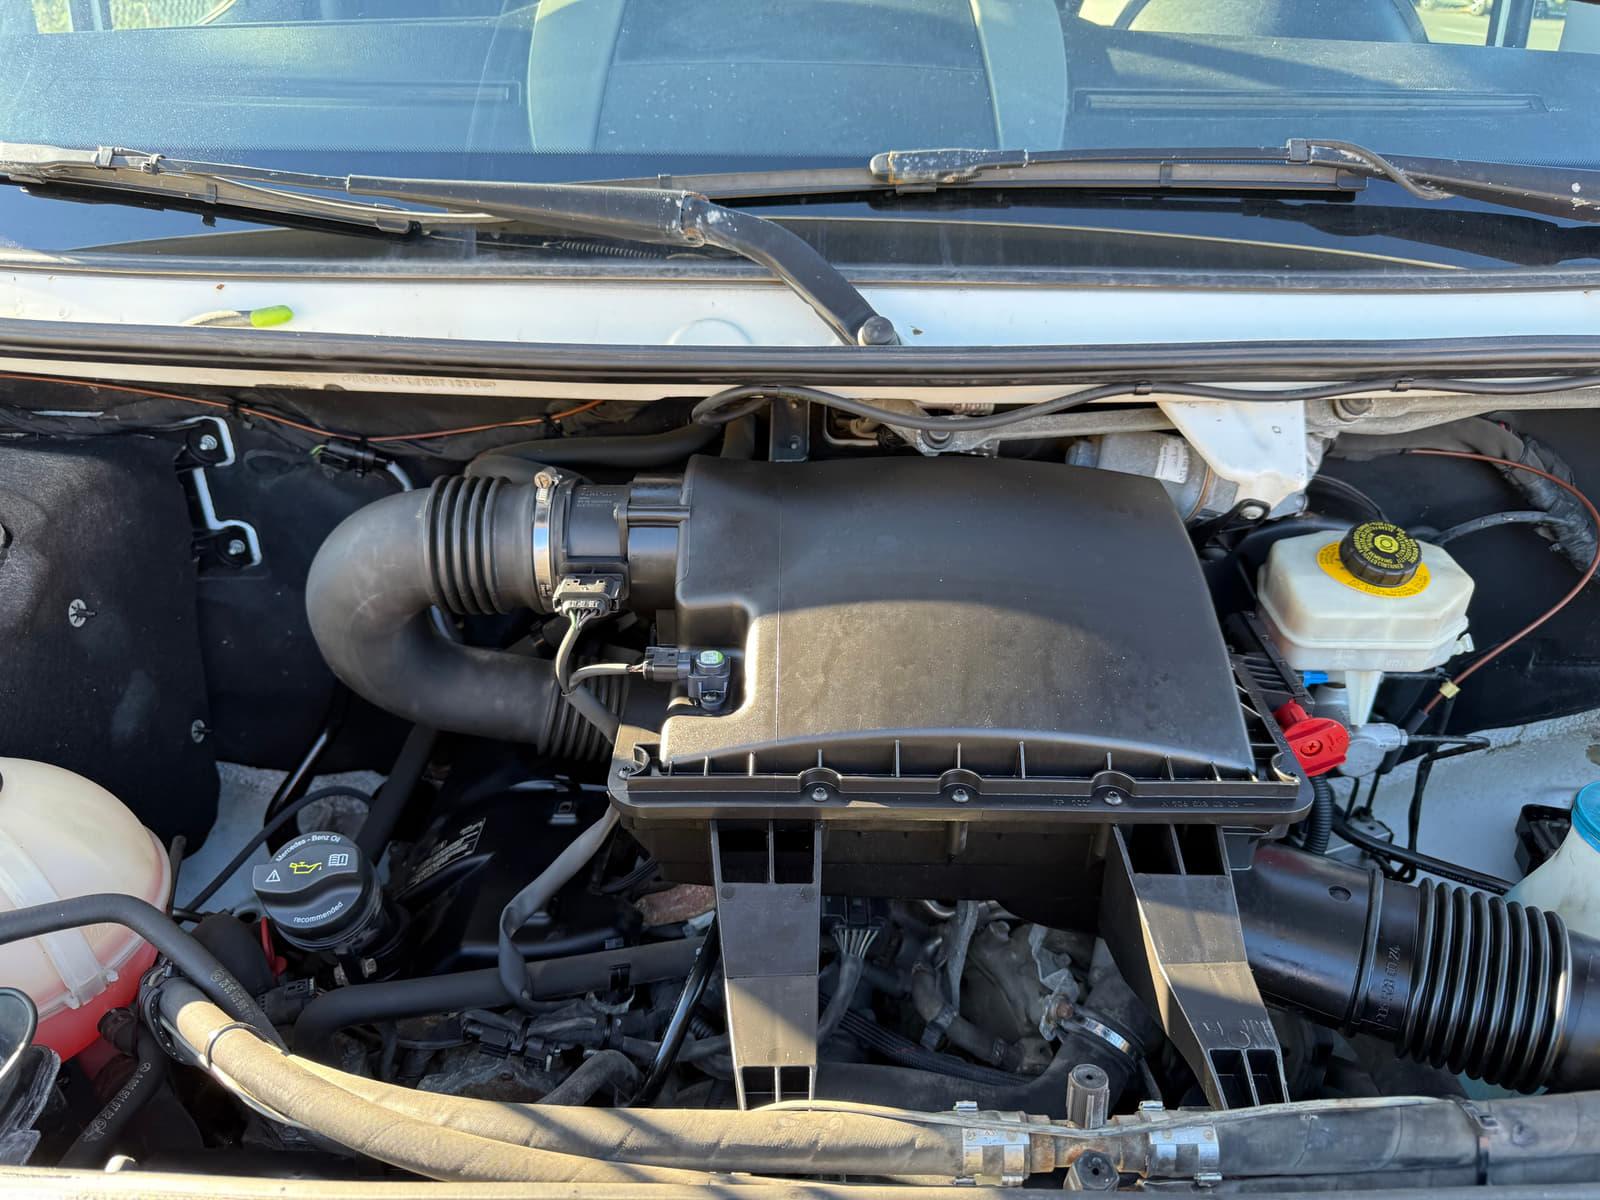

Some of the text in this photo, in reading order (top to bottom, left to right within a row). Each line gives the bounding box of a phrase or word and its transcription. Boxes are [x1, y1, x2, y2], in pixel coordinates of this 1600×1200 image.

[275, 839, 306, 861] Mercedes
[311, 834, 330, 842] Benz
[293, 901, 344, 923] recommended
